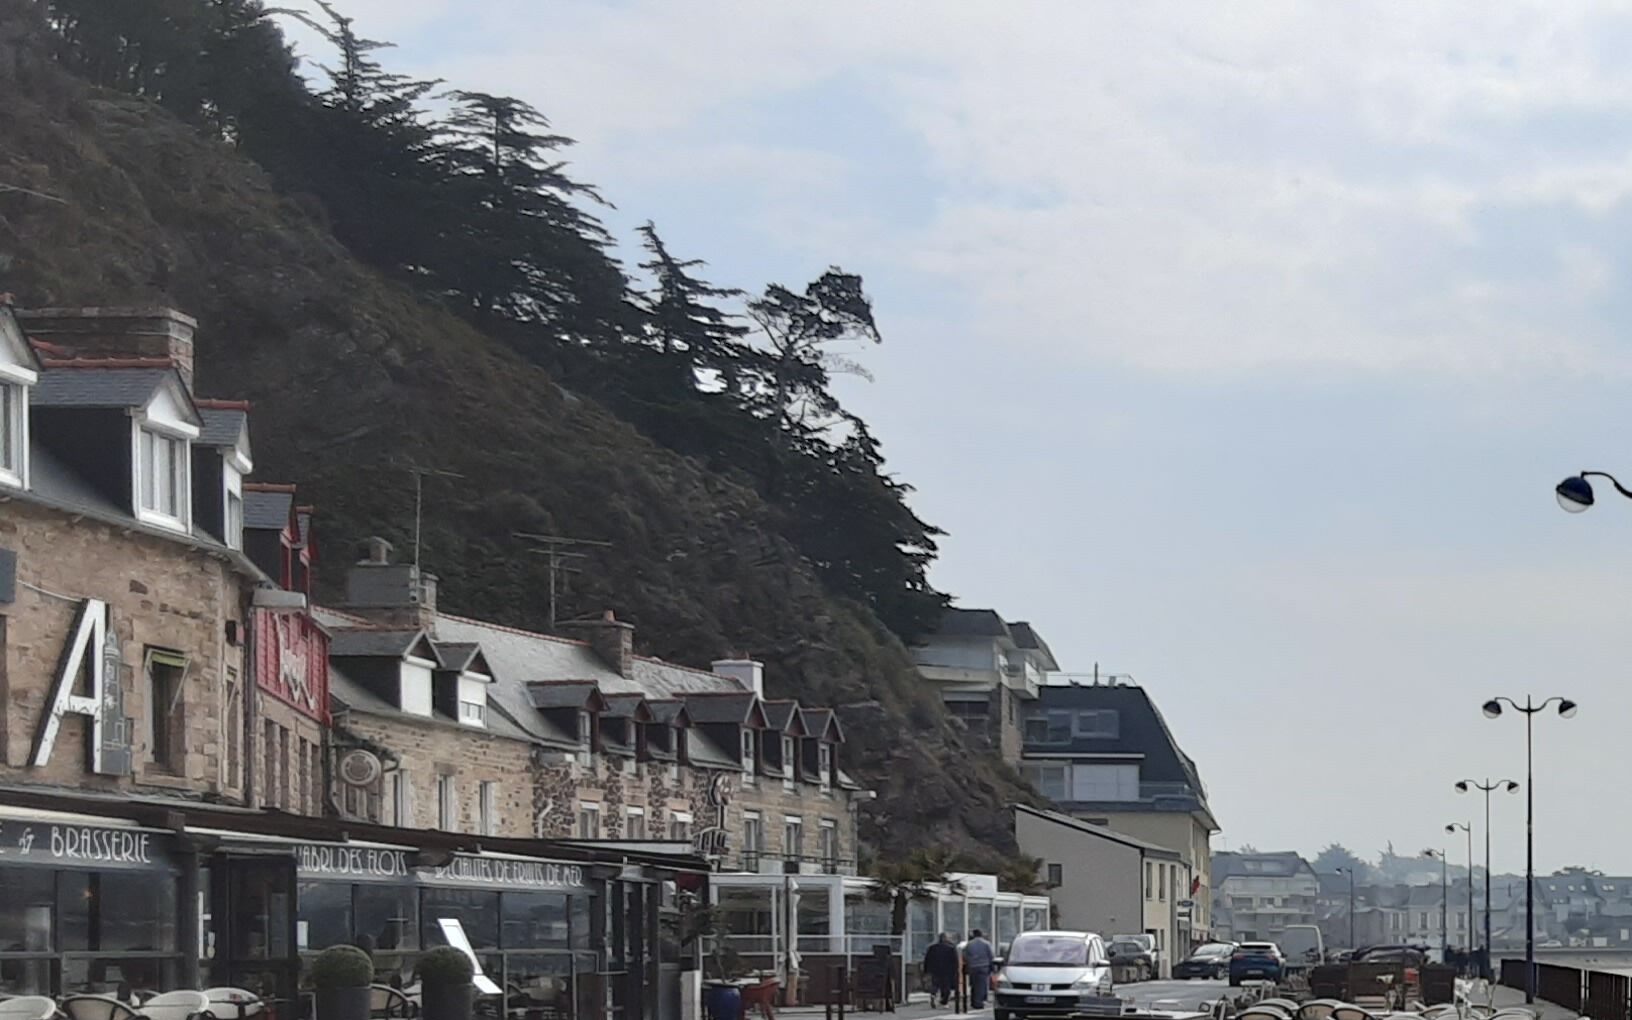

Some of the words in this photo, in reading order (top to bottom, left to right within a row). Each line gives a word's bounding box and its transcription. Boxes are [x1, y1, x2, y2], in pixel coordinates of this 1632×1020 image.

[51, 825, 152, 864] BRASSERIE
[338, 847, 363, 874] DES
[367, 849, 409, 876] FLOTS
[494, 858, 513, 884] DE
[546, 863, 561, 886] DE
[562, 865, 585, 888] MER
